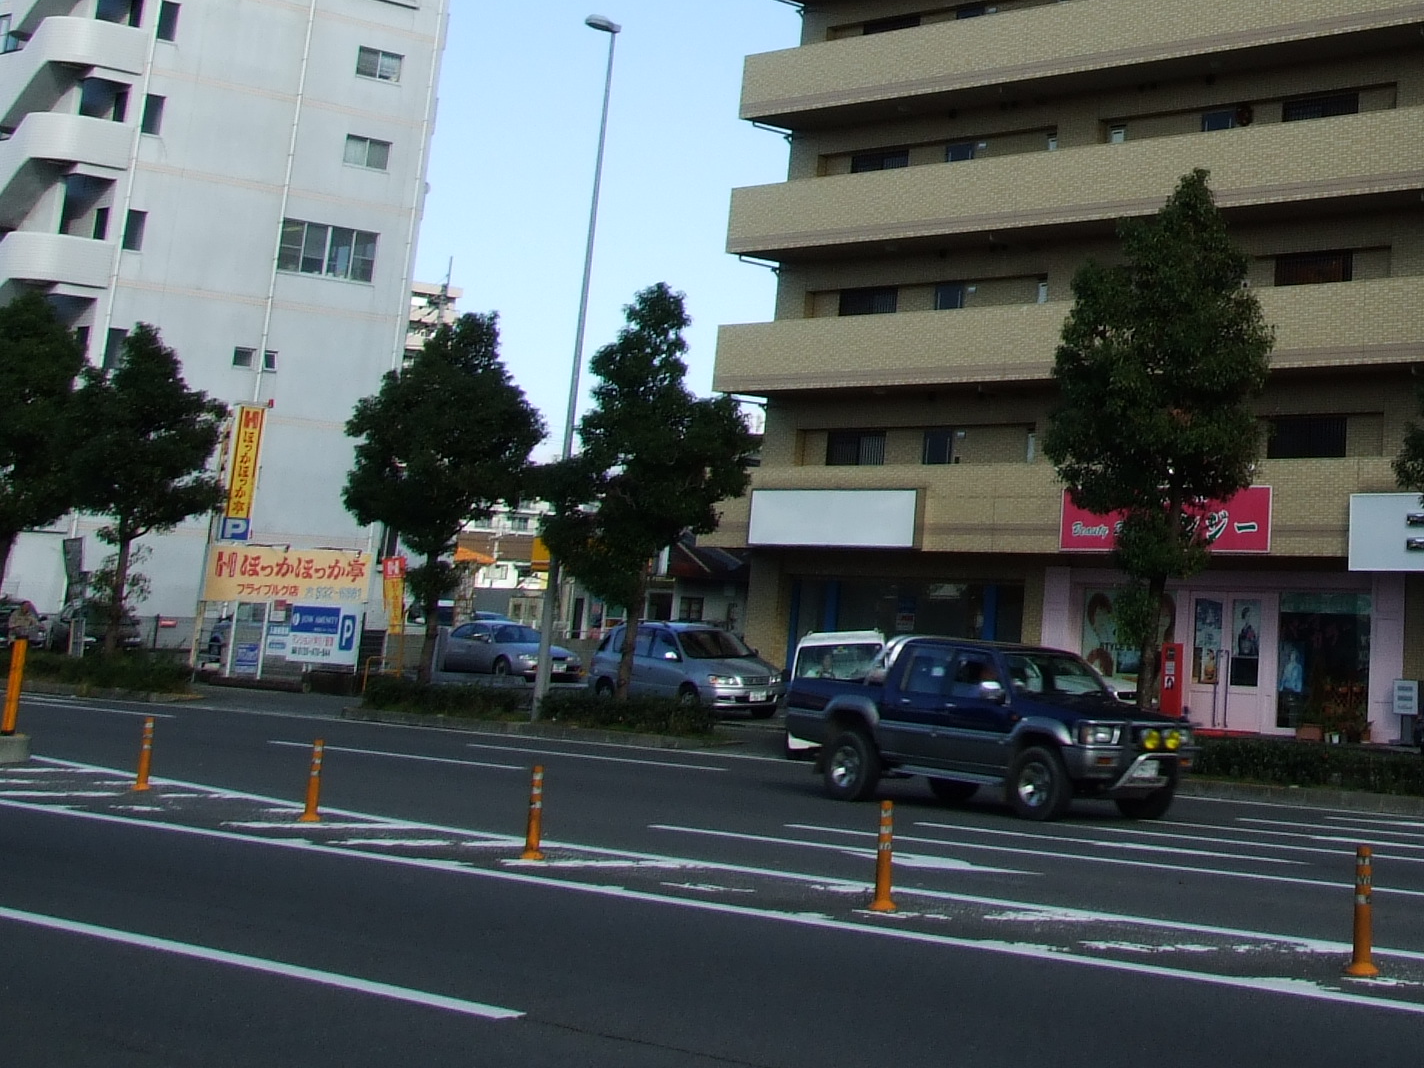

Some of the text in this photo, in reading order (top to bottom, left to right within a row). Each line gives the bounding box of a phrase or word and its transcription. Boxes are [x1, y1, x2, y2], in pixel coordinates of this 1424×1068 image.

[232, 431, 255, 515] ほっかほっか亭
[224, 520, 247, 539] P
[1072, 520, 1109, 539] Beauty
[240, 554, 366, 583] ほっかほっか亭
[341, 619, 353, 646] P
